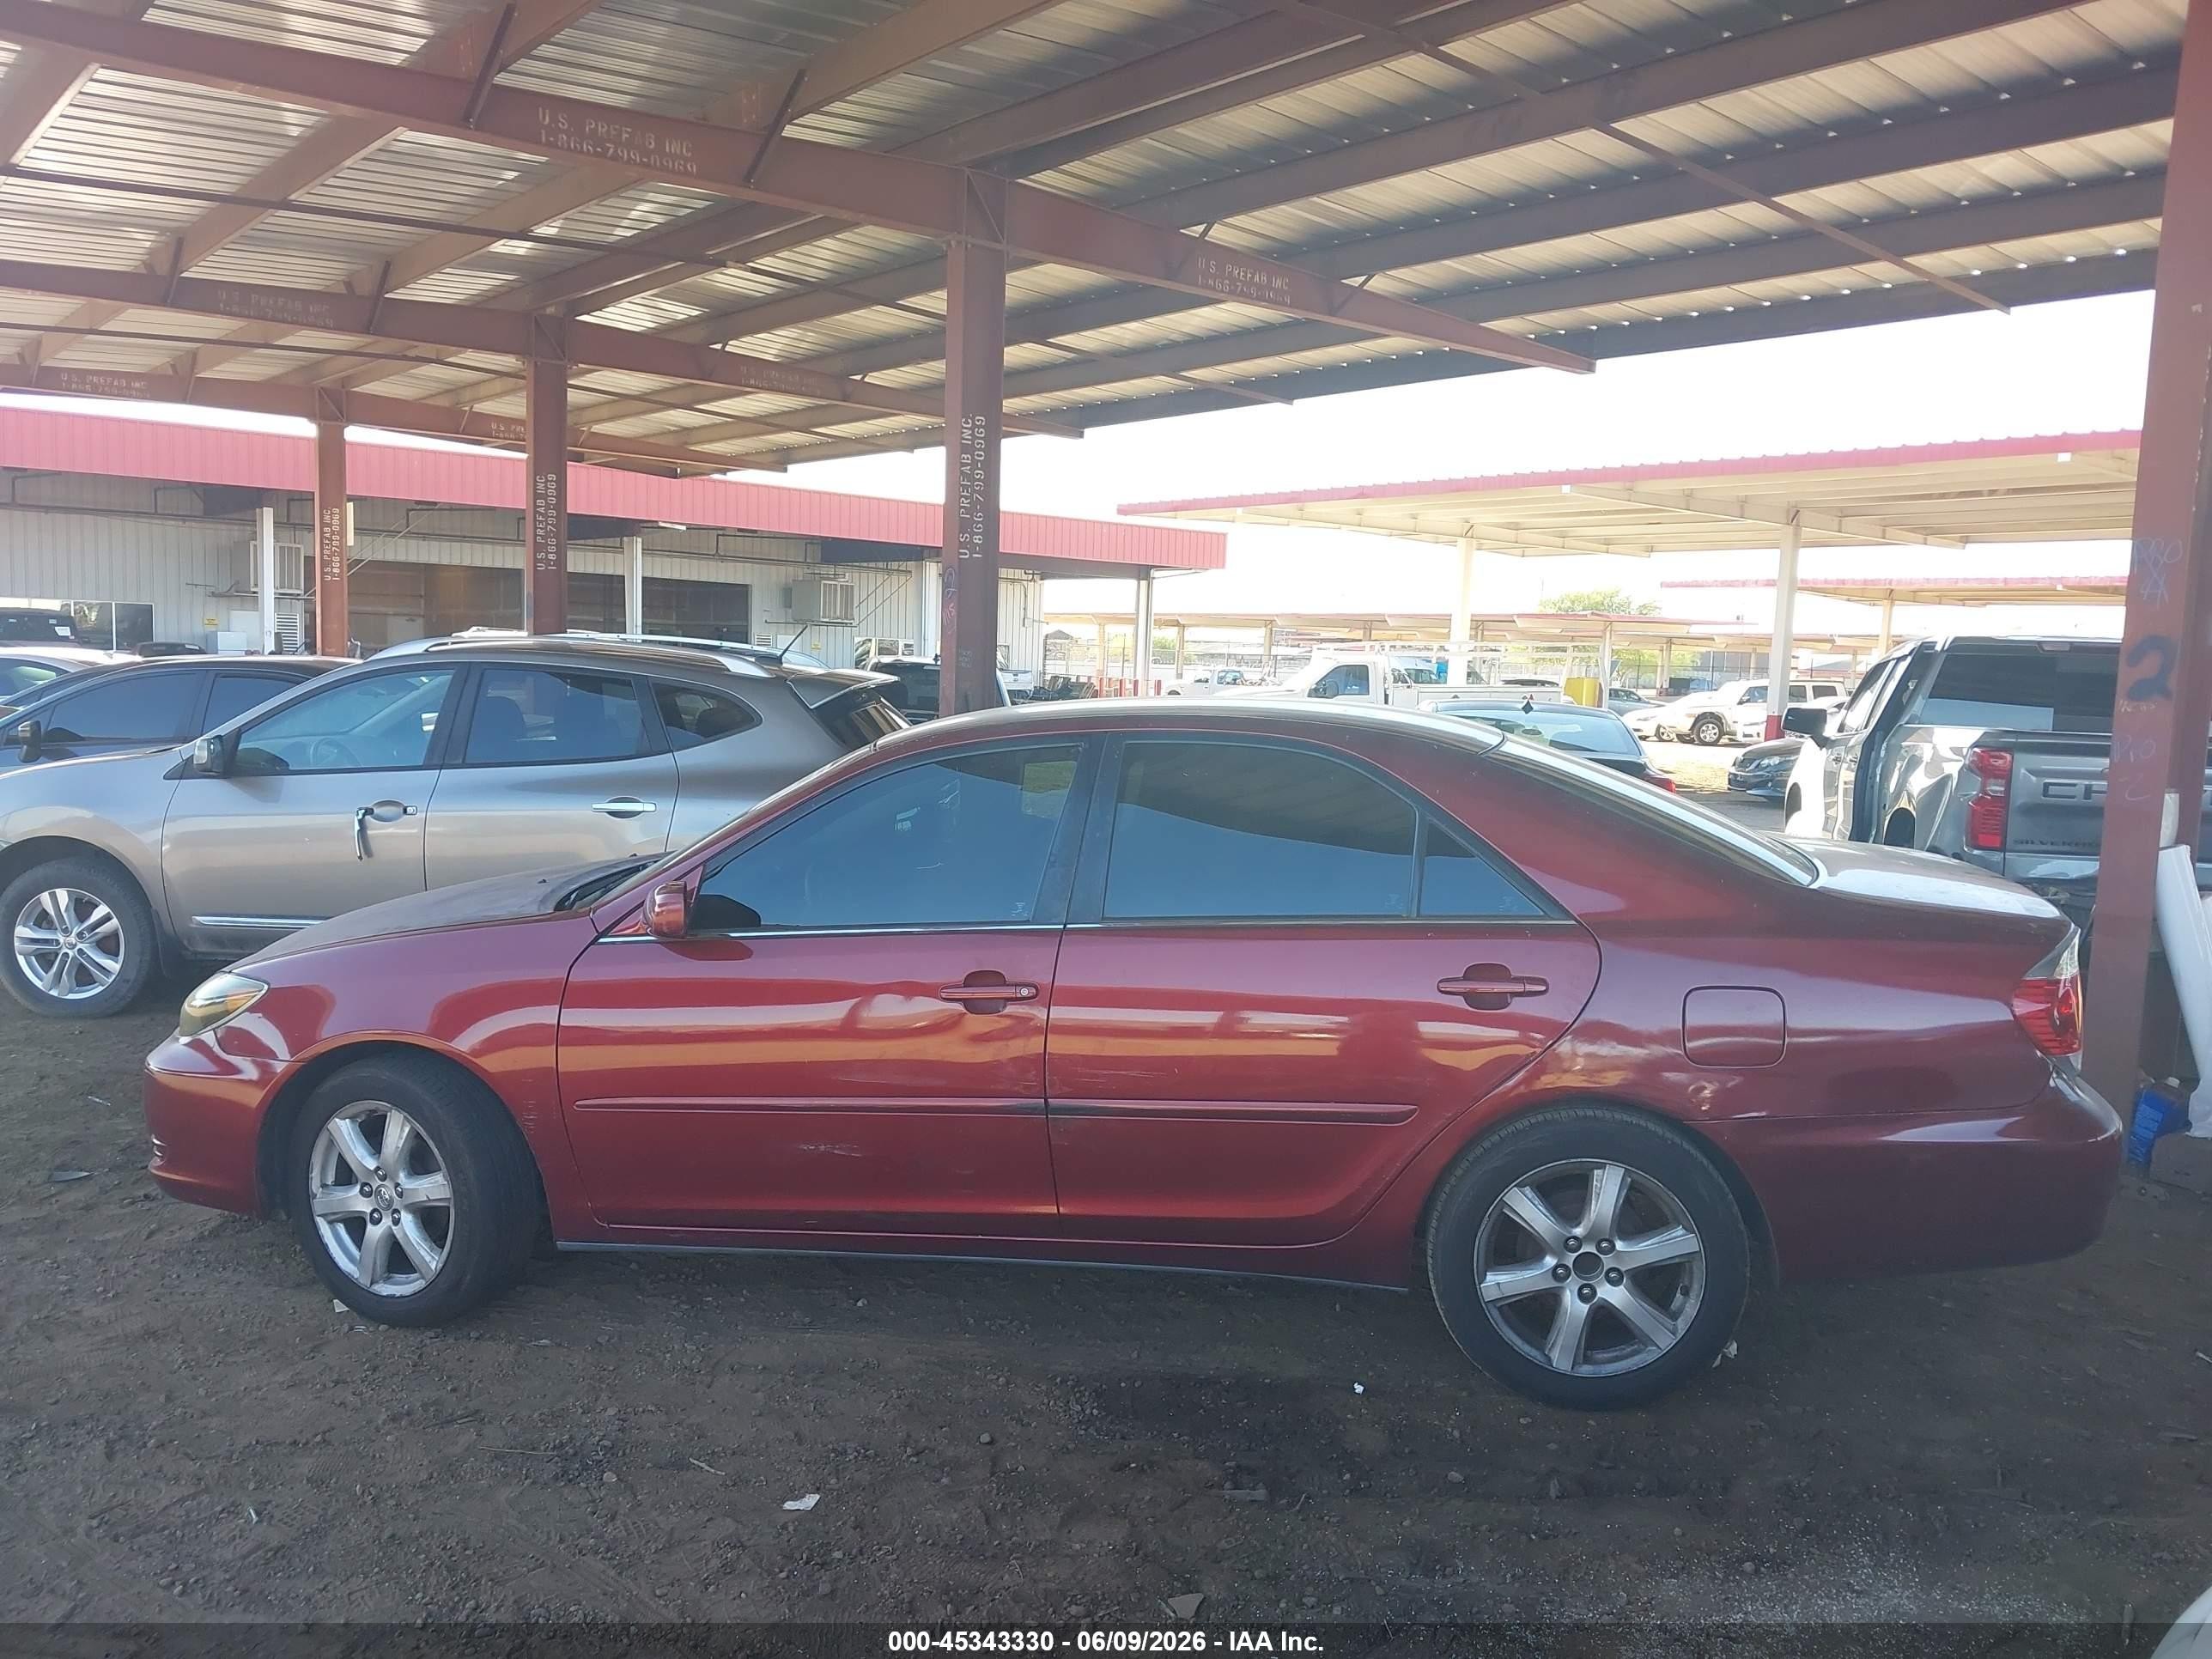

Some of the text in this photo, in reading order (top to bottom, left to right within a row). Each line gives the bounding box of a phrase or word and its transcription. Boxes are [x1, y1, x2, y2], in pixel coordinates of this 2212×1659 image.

[538, 106, 574, 131] U.S.
[585, 118, 655, 149] PREFAB
[1225, 262, 1267, 284] PREFAB
[958, 413, 973, 559] U.S. PREFAB INC.
[972, 415, 987, 558] 1-866-799-0969
[323, 526, 331, 561] PREFAB
[331, 507, 341, 581] 1-866-799-0969
[536, 498, 546, 544] PREFAB
[547, 473, 557, 570] 1-866-799-0969
[536, 549, 546, 570] U.S.
[2126, 634, 2174, 702] 2
